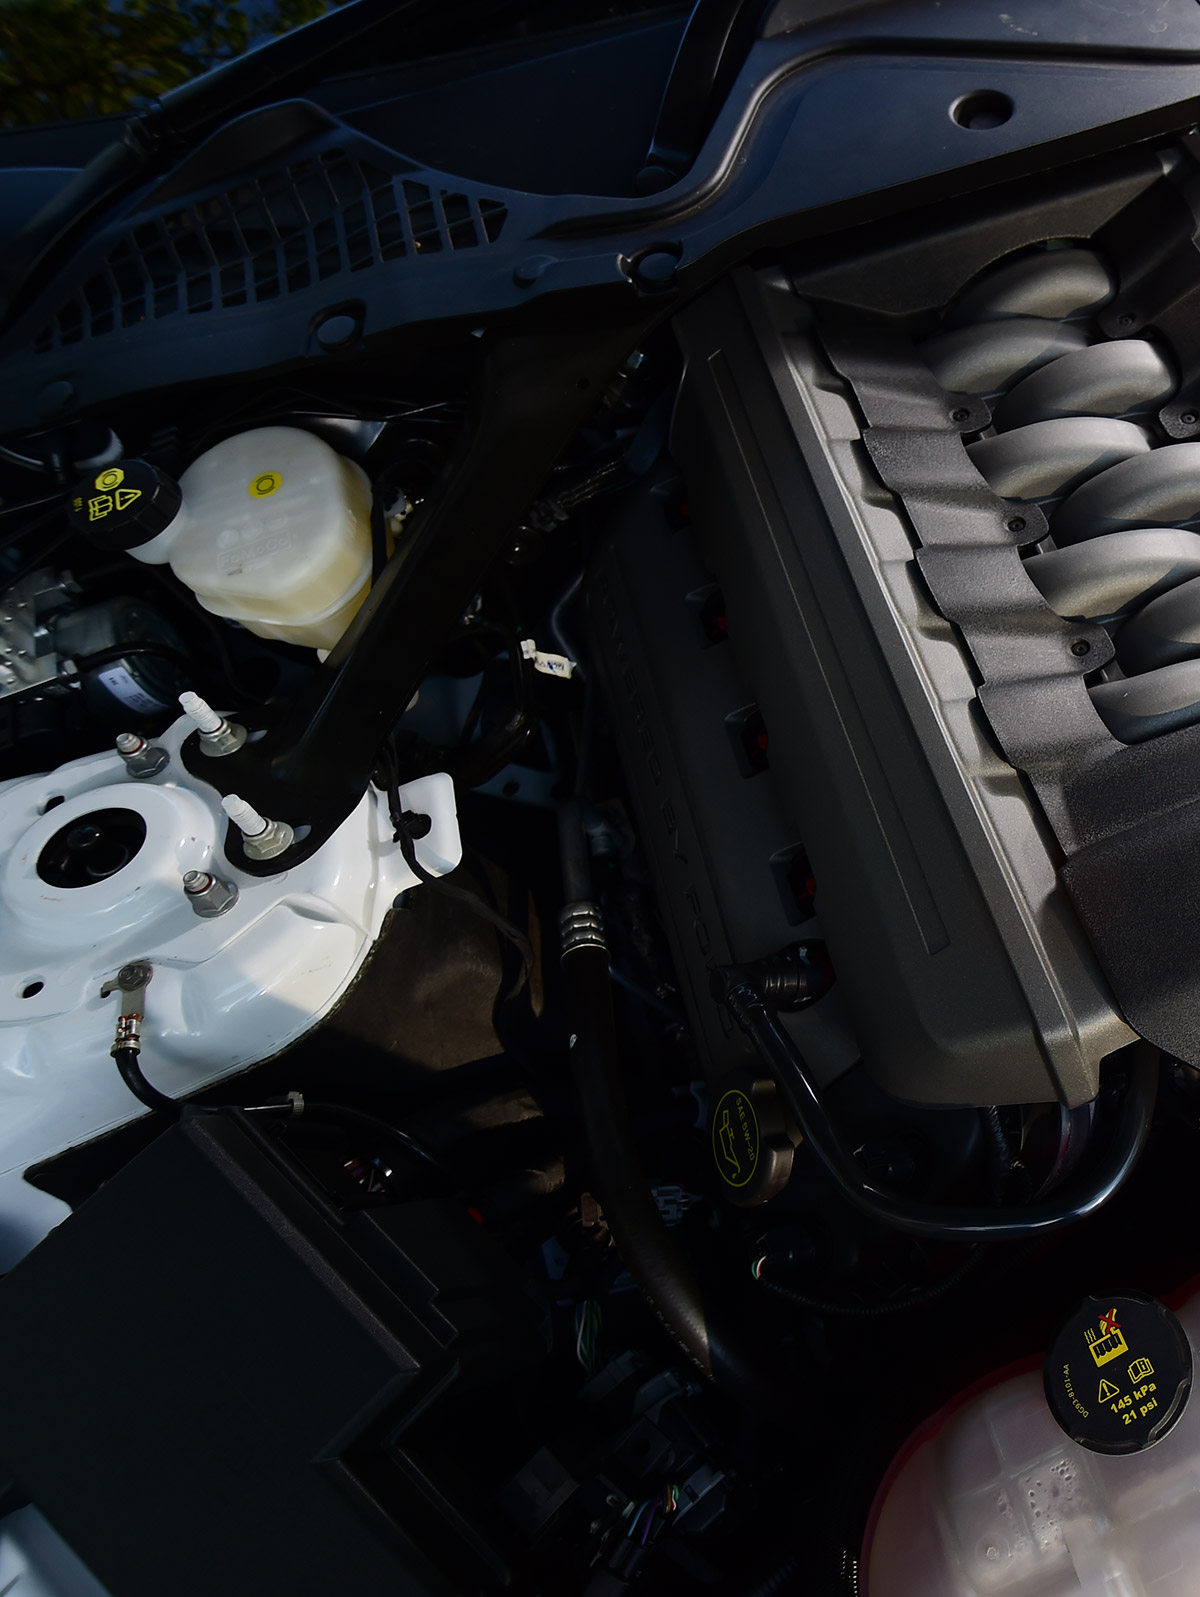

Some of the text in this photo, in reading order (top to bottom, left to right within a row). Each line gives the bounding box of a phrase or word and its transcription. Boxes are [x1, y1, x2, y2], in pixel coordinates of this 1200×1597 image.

[659, 797, 688, 865] BY
[683, 886, 734, 1040] FOD
[736, 1096, 756, 1161] SAE 5W-20
[1062, 1362, 1091, 1419] DG93-8101-AA
[1110, 1382, 1157, 1414] 145 kPa
[1121, 1396, 1159, 1425] 21 psi
